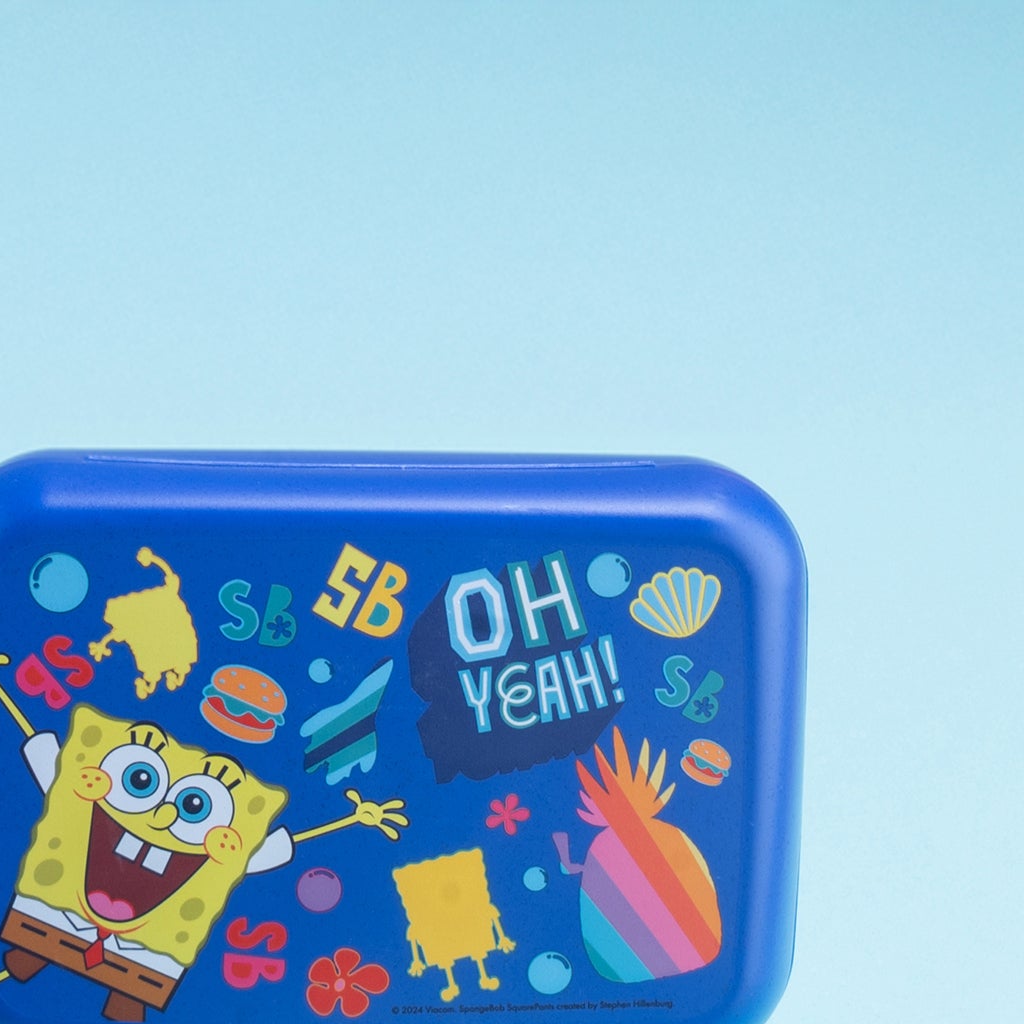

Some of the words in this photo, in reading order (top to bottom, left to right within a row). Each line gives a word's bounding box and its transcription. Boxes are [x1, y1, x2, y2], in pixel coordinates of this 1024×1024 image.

[218, 579, 297, 647] SB
[311, 542, 408, 638] SB
[444, 550, 588, 662] OH
[15, 634, 95, 710] SB
[458, 634, 625, 734] YEAH!
[654, 655, 725, 724] SB
[222, 916, 288, 989] SB
[401, 1005, 422, 1014] 2024
[459, 1003, 505, 1014] SpongeBob
[507, 1002, 555, 1013] SquarePants
[556, 1001, 586, 1010] created
[587, 1001, 598, 1011] by
[599, 1000, 631, 1011] Stephen
